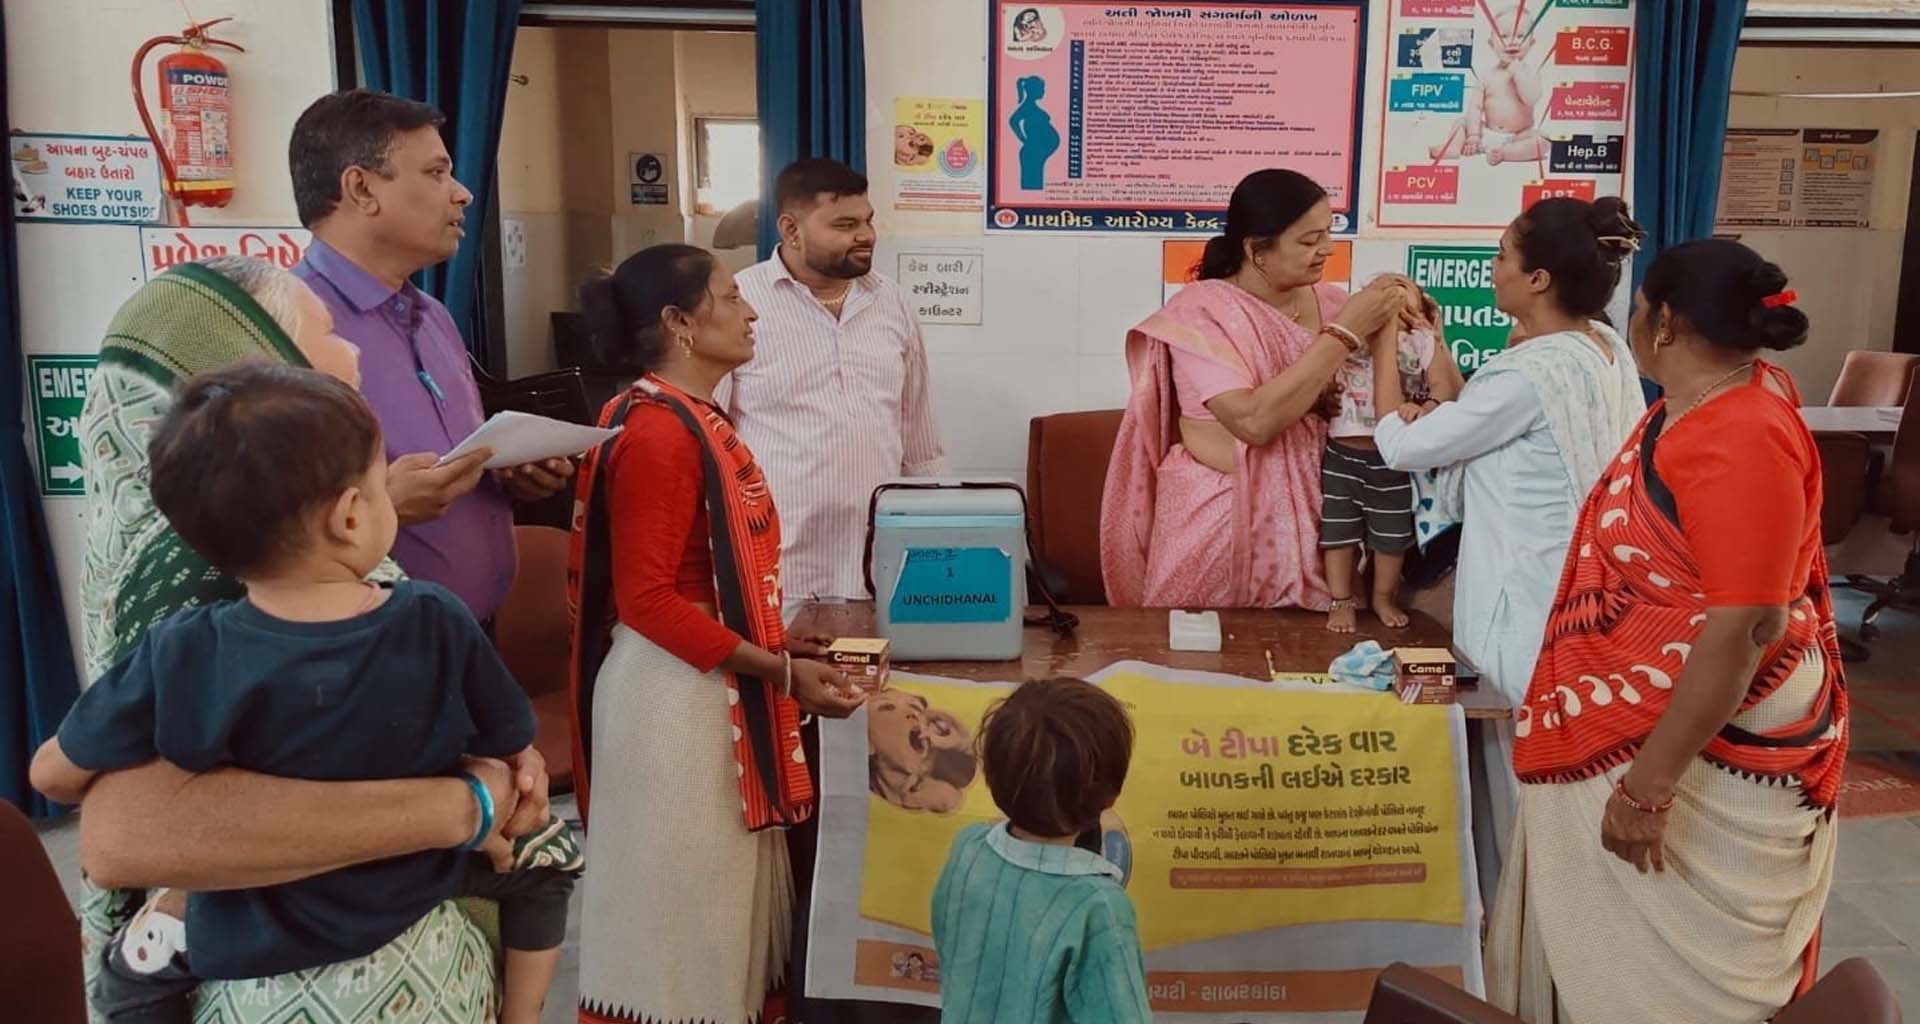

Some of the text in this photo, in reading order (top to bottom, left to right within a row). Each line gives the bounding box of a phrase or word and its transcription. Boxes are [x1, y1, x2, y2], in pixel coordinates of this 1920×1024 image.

[1270, 11, 1318, 22] ઓળખ
[1572, 37, 1614, 50] B.C.G.
[1412, 84, 1443, 97] FIPV
[46, 144, 87, 155] આપના
[1568, 145, 1607, 159] Hep.B
[65, 167, 96, 179] બહાર
[1407, 176, 1436, 189] PCV
[66, 188, 142, 201] KEEP YOUR
[53, 203, 97, 216] SHOES
[1025, 210, 1093, 228] પ્રાથમિક
[1105, 211, 1173, 229] આરોગ્ય
[1416, 258, 1496, 288] EMERGE
[834, 652, 870, 663] Camel
[1408, 663, 1446, 674] Camel
[1181, 726, 1397, 759] બે ટીપા દરેક વાર
[1180, 761, 1411, 789] બાળકની લઈએ દરકાર
